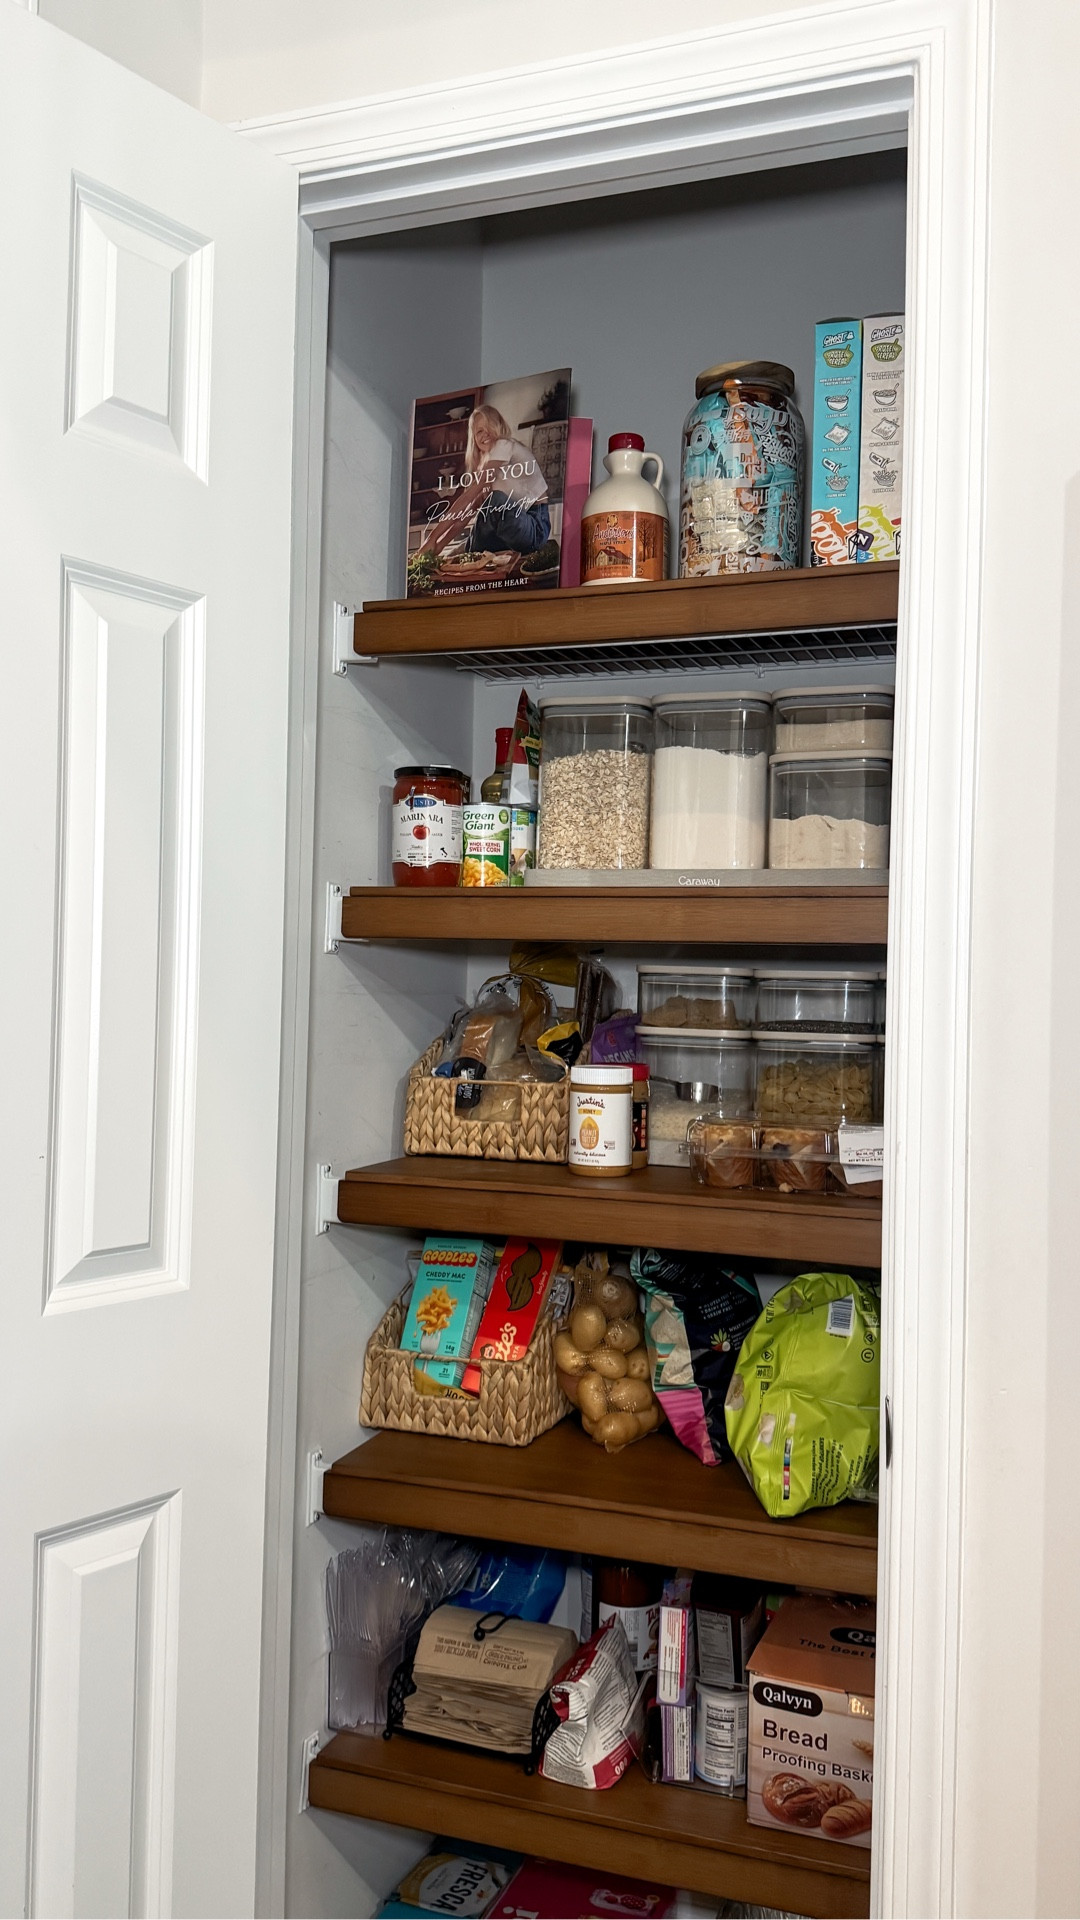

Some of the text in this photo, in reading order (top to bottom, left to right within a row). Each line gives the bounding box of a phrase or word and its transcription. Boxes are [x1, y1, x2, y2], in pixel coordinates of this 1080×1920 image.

[437, 459, 537, 491] I LOVE YOU
[425, 489, 549, 533] Pamela Anderson
[434, 577, 529, 596] RECIPES FROM THE HEART
[400, 813, 443, 824] MARINARA
[463, 810, 494, 820] Green
[465, 820, 495, 830] Giant
[678, 875, 720, 887] Caraway
[576, 1096, 605, 1109] Justin's
[422, 1249, 477, 1265] GOODLES
[425, 1271, 450, 1279] CHEDDY
[799, 1637, 826, 1650] The
[831, 1645, 865, 1658] Best
[762, 1686, 813, 1710] Qalvyn
[762, 1718, 829, 1752] Bread
[762, 1746, 874, 1784] Proofing Bask
[431, 1862, 489, 1911] FRESCA
